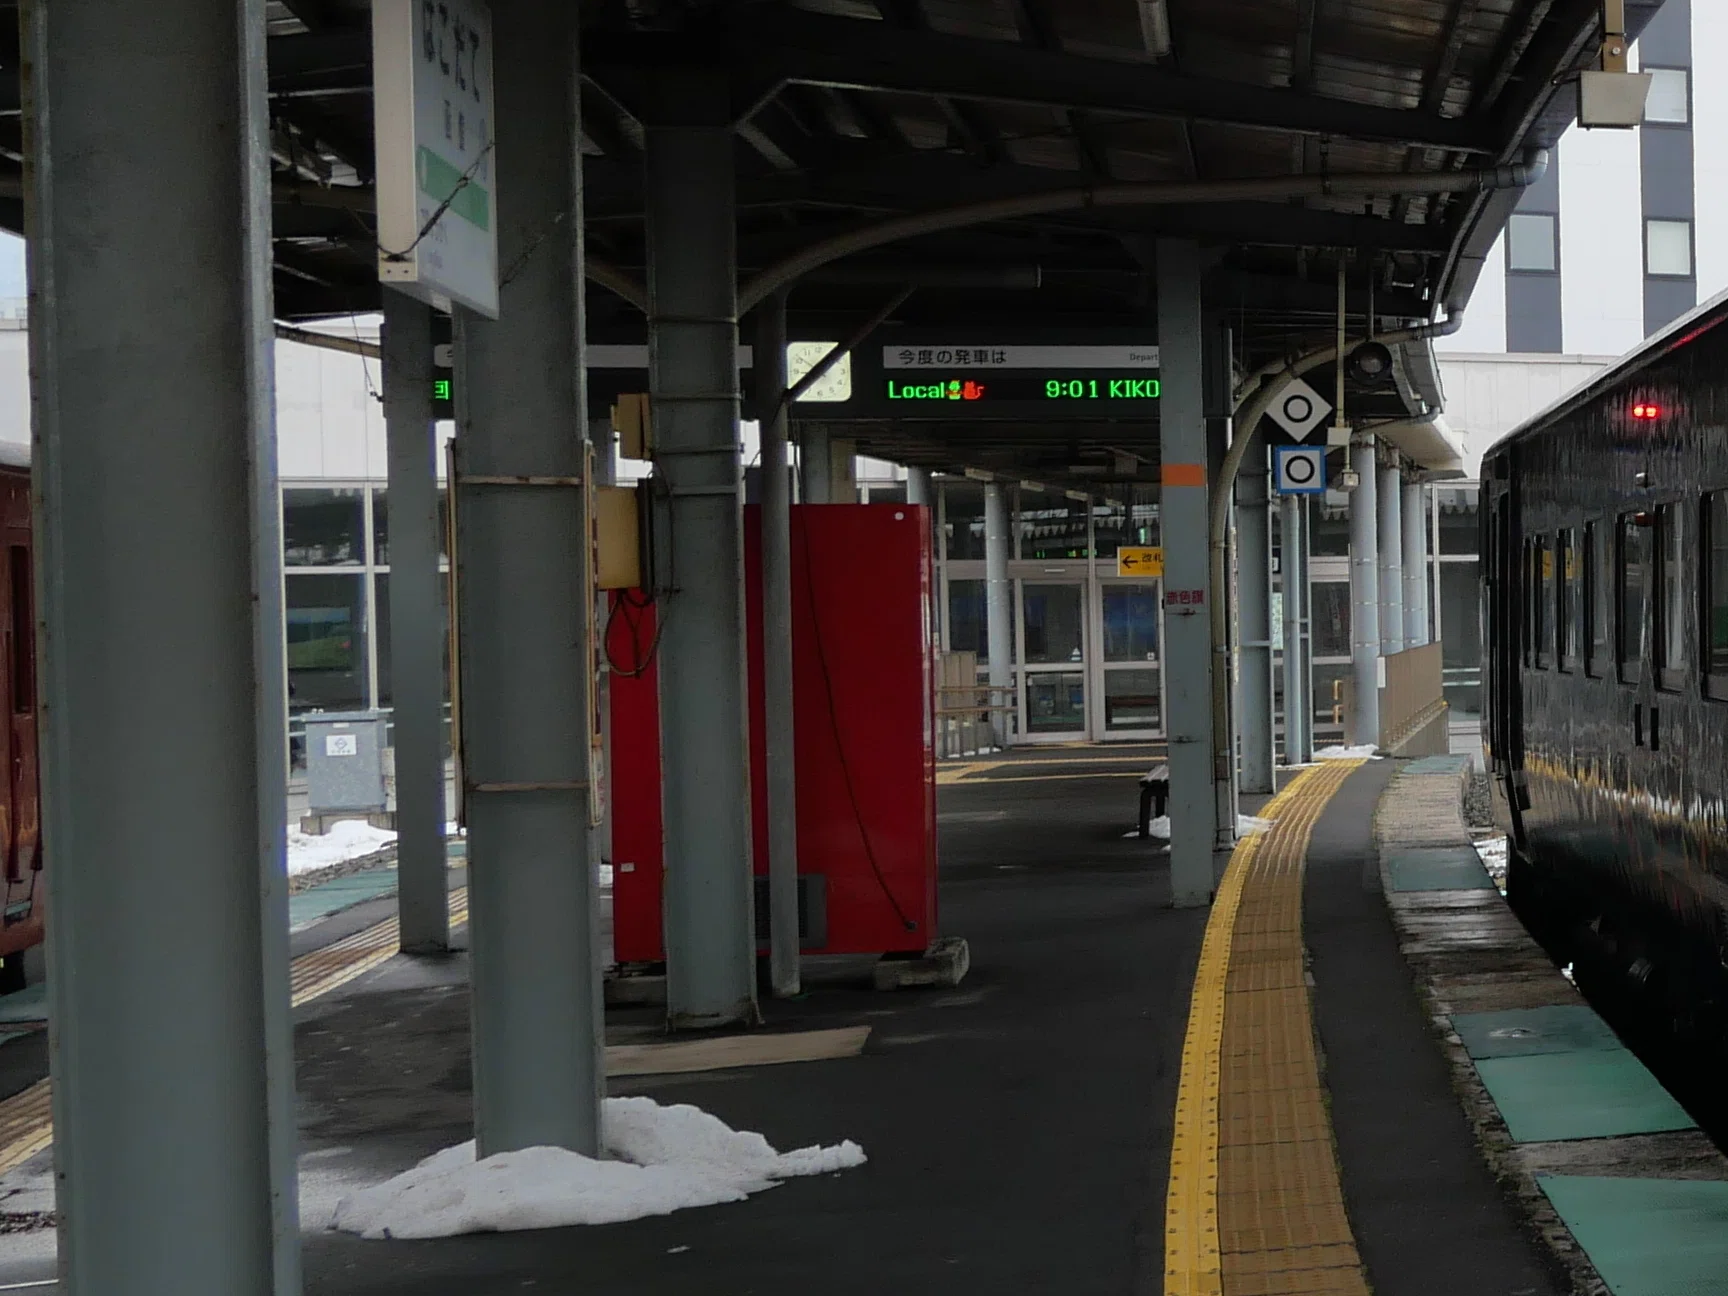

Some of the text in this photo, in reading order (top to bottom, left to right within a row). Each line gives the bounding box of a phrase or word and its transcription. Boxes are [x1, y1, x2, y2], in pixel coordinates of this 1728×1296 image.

[898, 349, 1007, 365] 今度の発車は
[888, 380, 1159, 399] Local 9:01 KIKO
